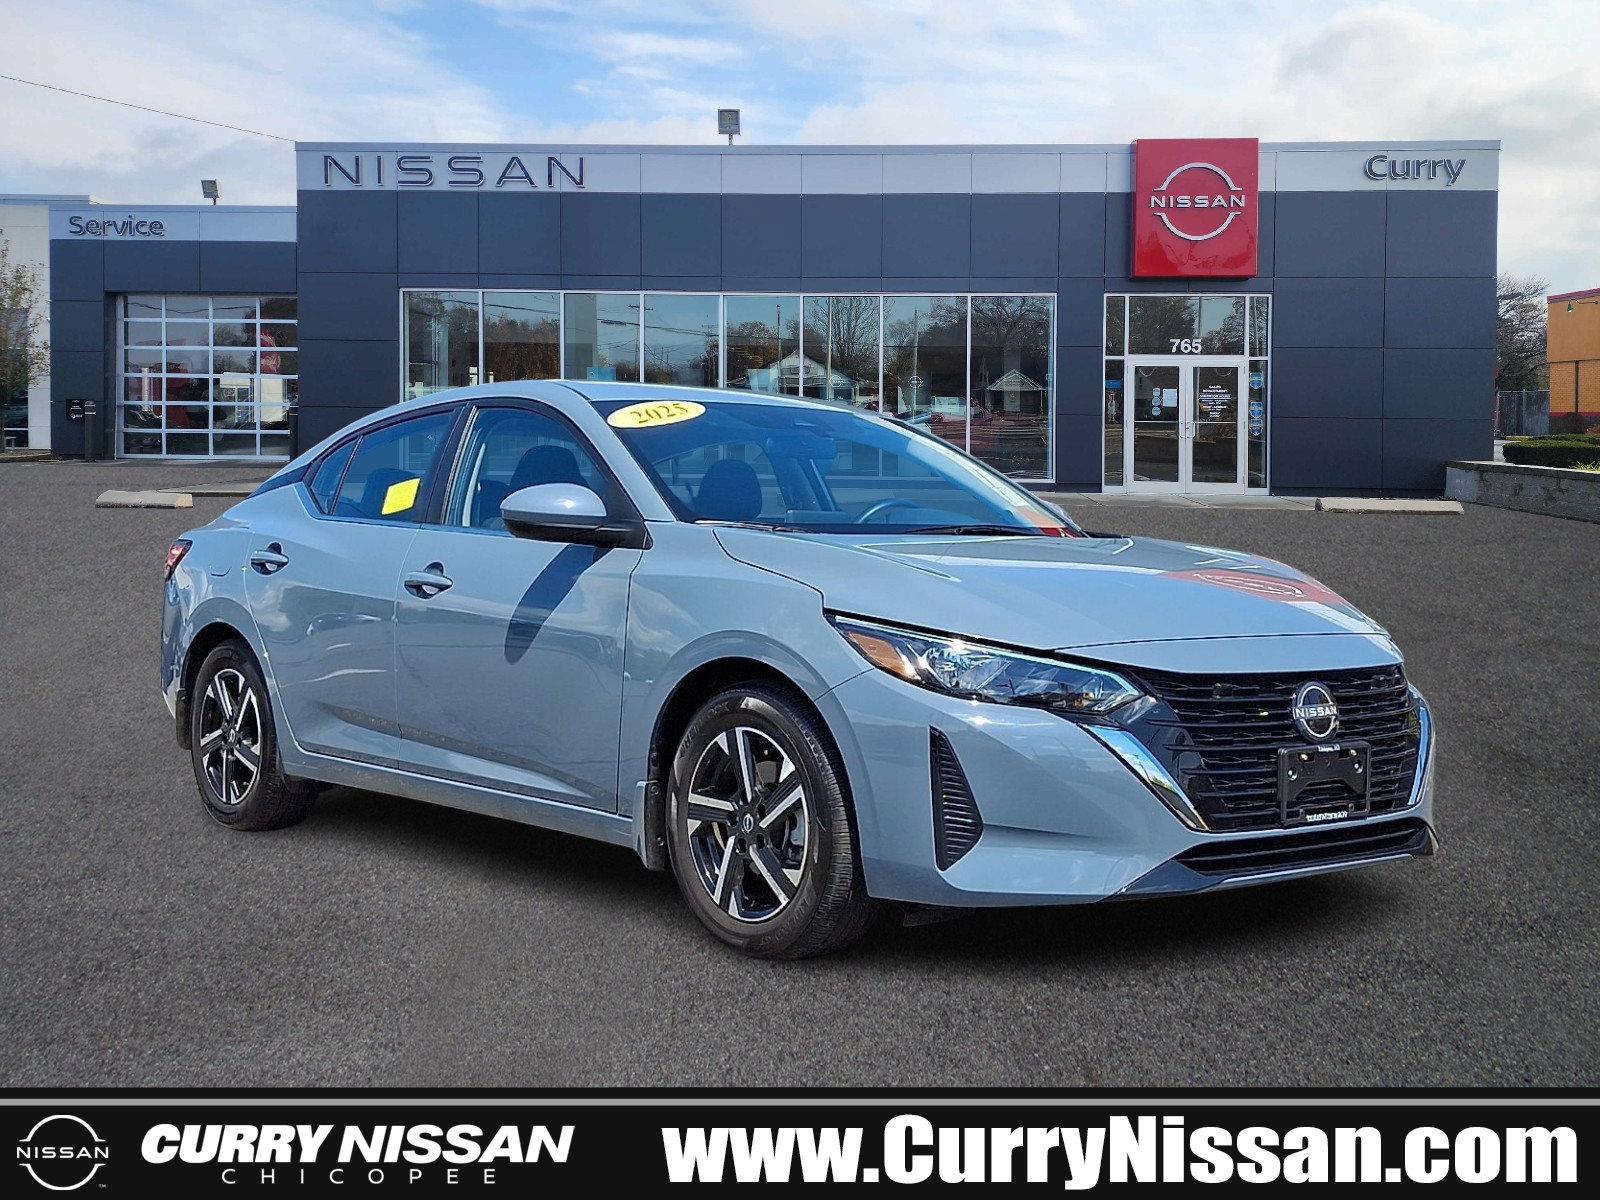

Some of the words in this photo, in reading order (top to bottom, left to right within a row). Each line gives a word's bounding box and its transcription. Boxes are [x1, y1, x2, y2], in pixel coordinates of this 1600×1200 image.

[323, 155, 585, 188] NISSAN
[1364, 154, 1466, 186] Curry
[1150, 194, 1246, 208] NISSAN
[68, 214, 166, 237] Service
[1169, 338, 1203, 354] 765
[630, 403, 688, 423] 2025
[1295, 706, 1337, 718] NISSAN
